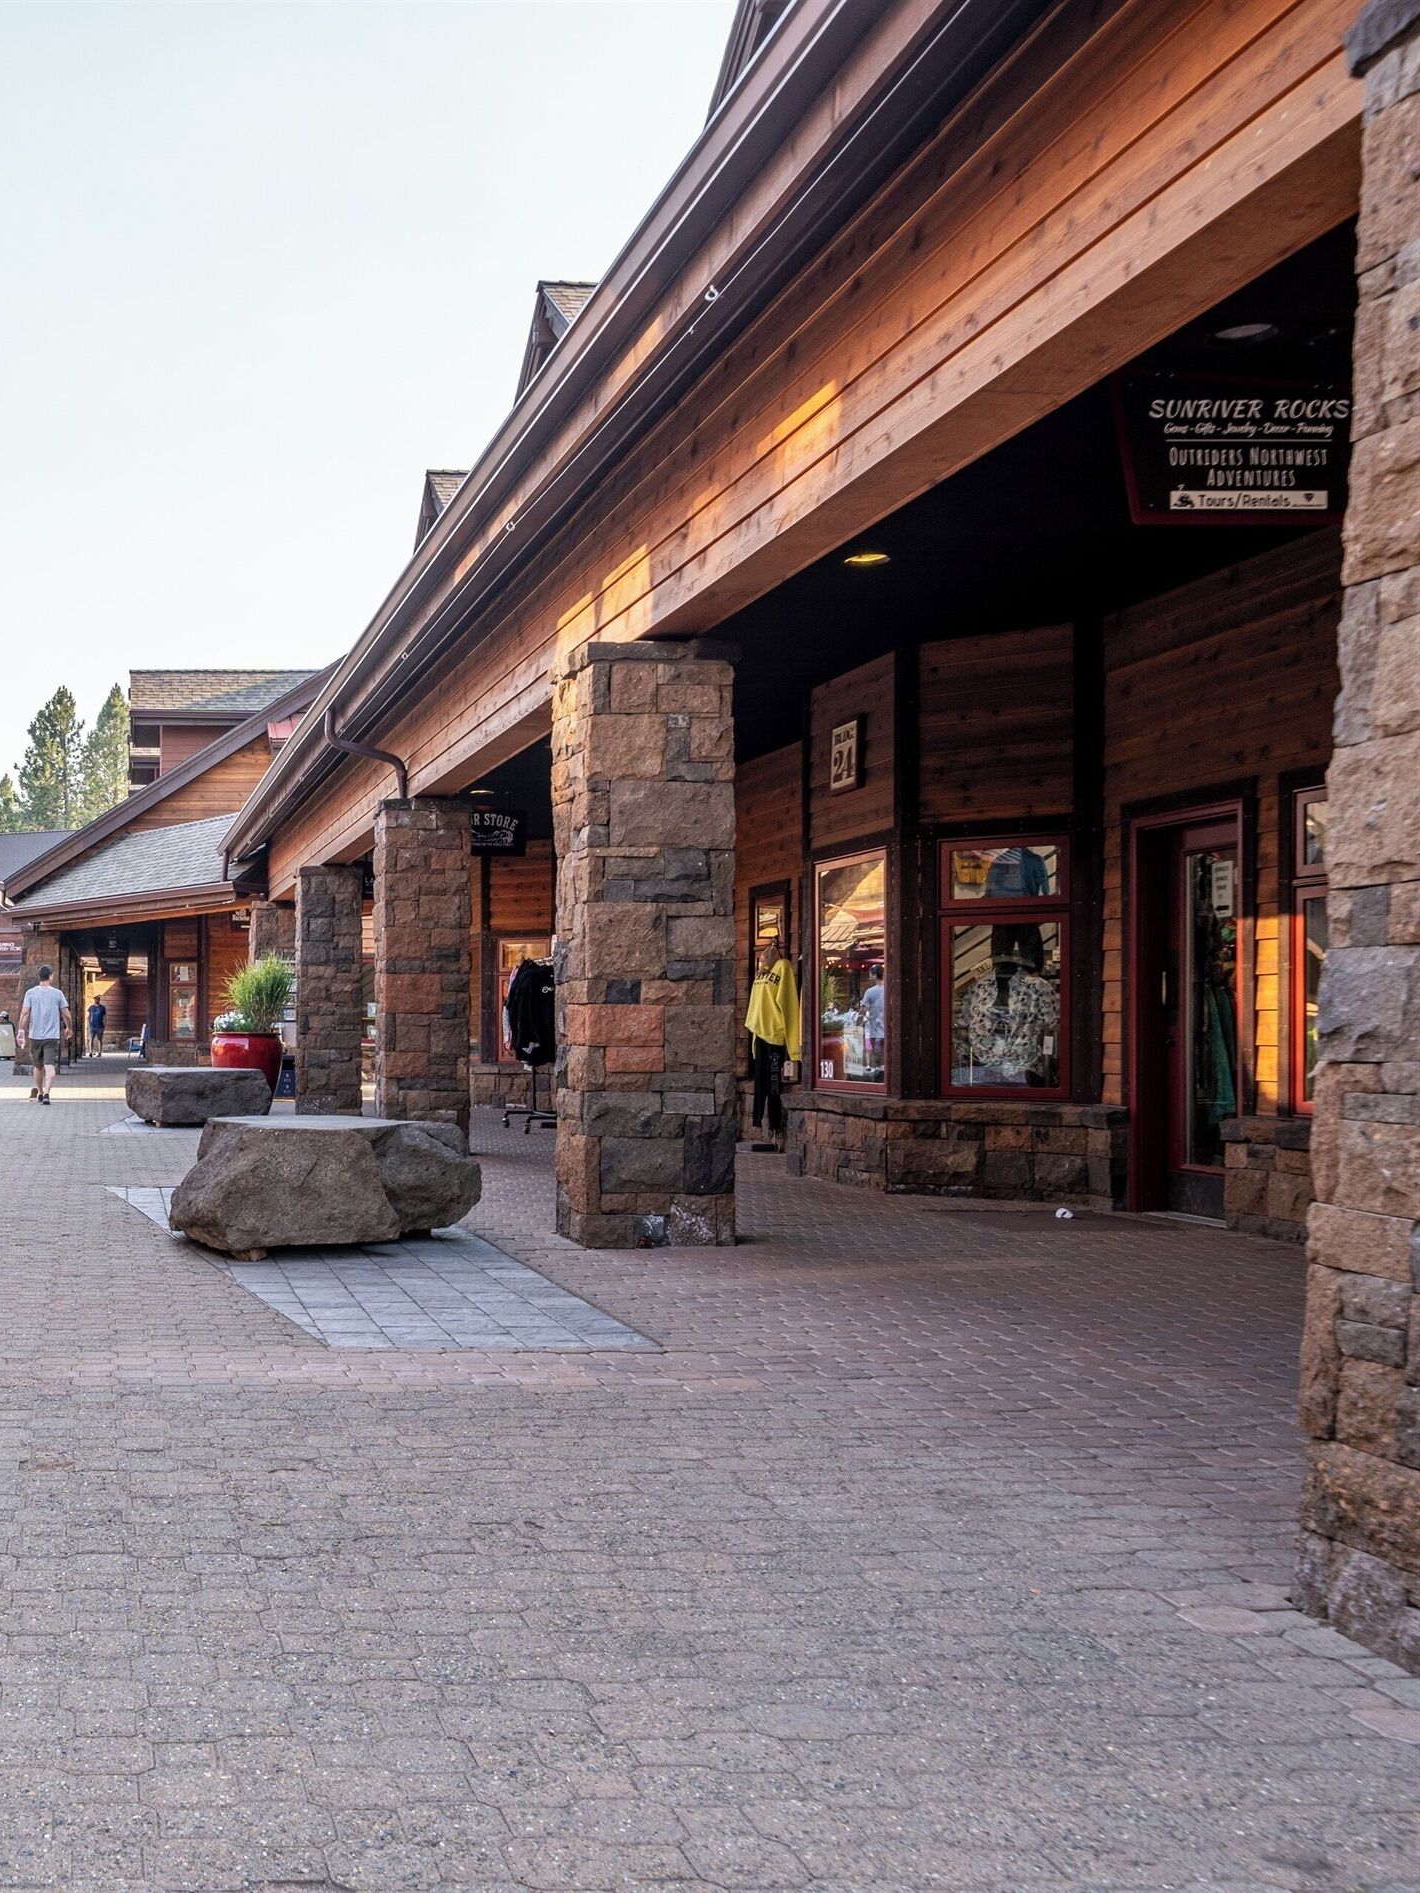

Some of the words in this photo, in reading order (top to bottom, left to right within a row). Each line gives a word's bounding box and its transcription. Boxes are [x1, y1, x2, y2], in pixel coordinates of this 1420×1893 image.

[1148, 399, 1263, 419] SUNRIVER
[1274, 399, 1350, 419] ROCKS
[1169, 447, 1244, 466] OUTRIDERS
[1249, 446, 1328, 466] NORTHWEST
[1206, 468, 1296, 487] ADVENTURES
[833, 745, 854, 784] 24
[483, 813, 519, 831] STORE
[976, 962, 991, 976] 3XL
[820, 1061, 834, 1079] 130
